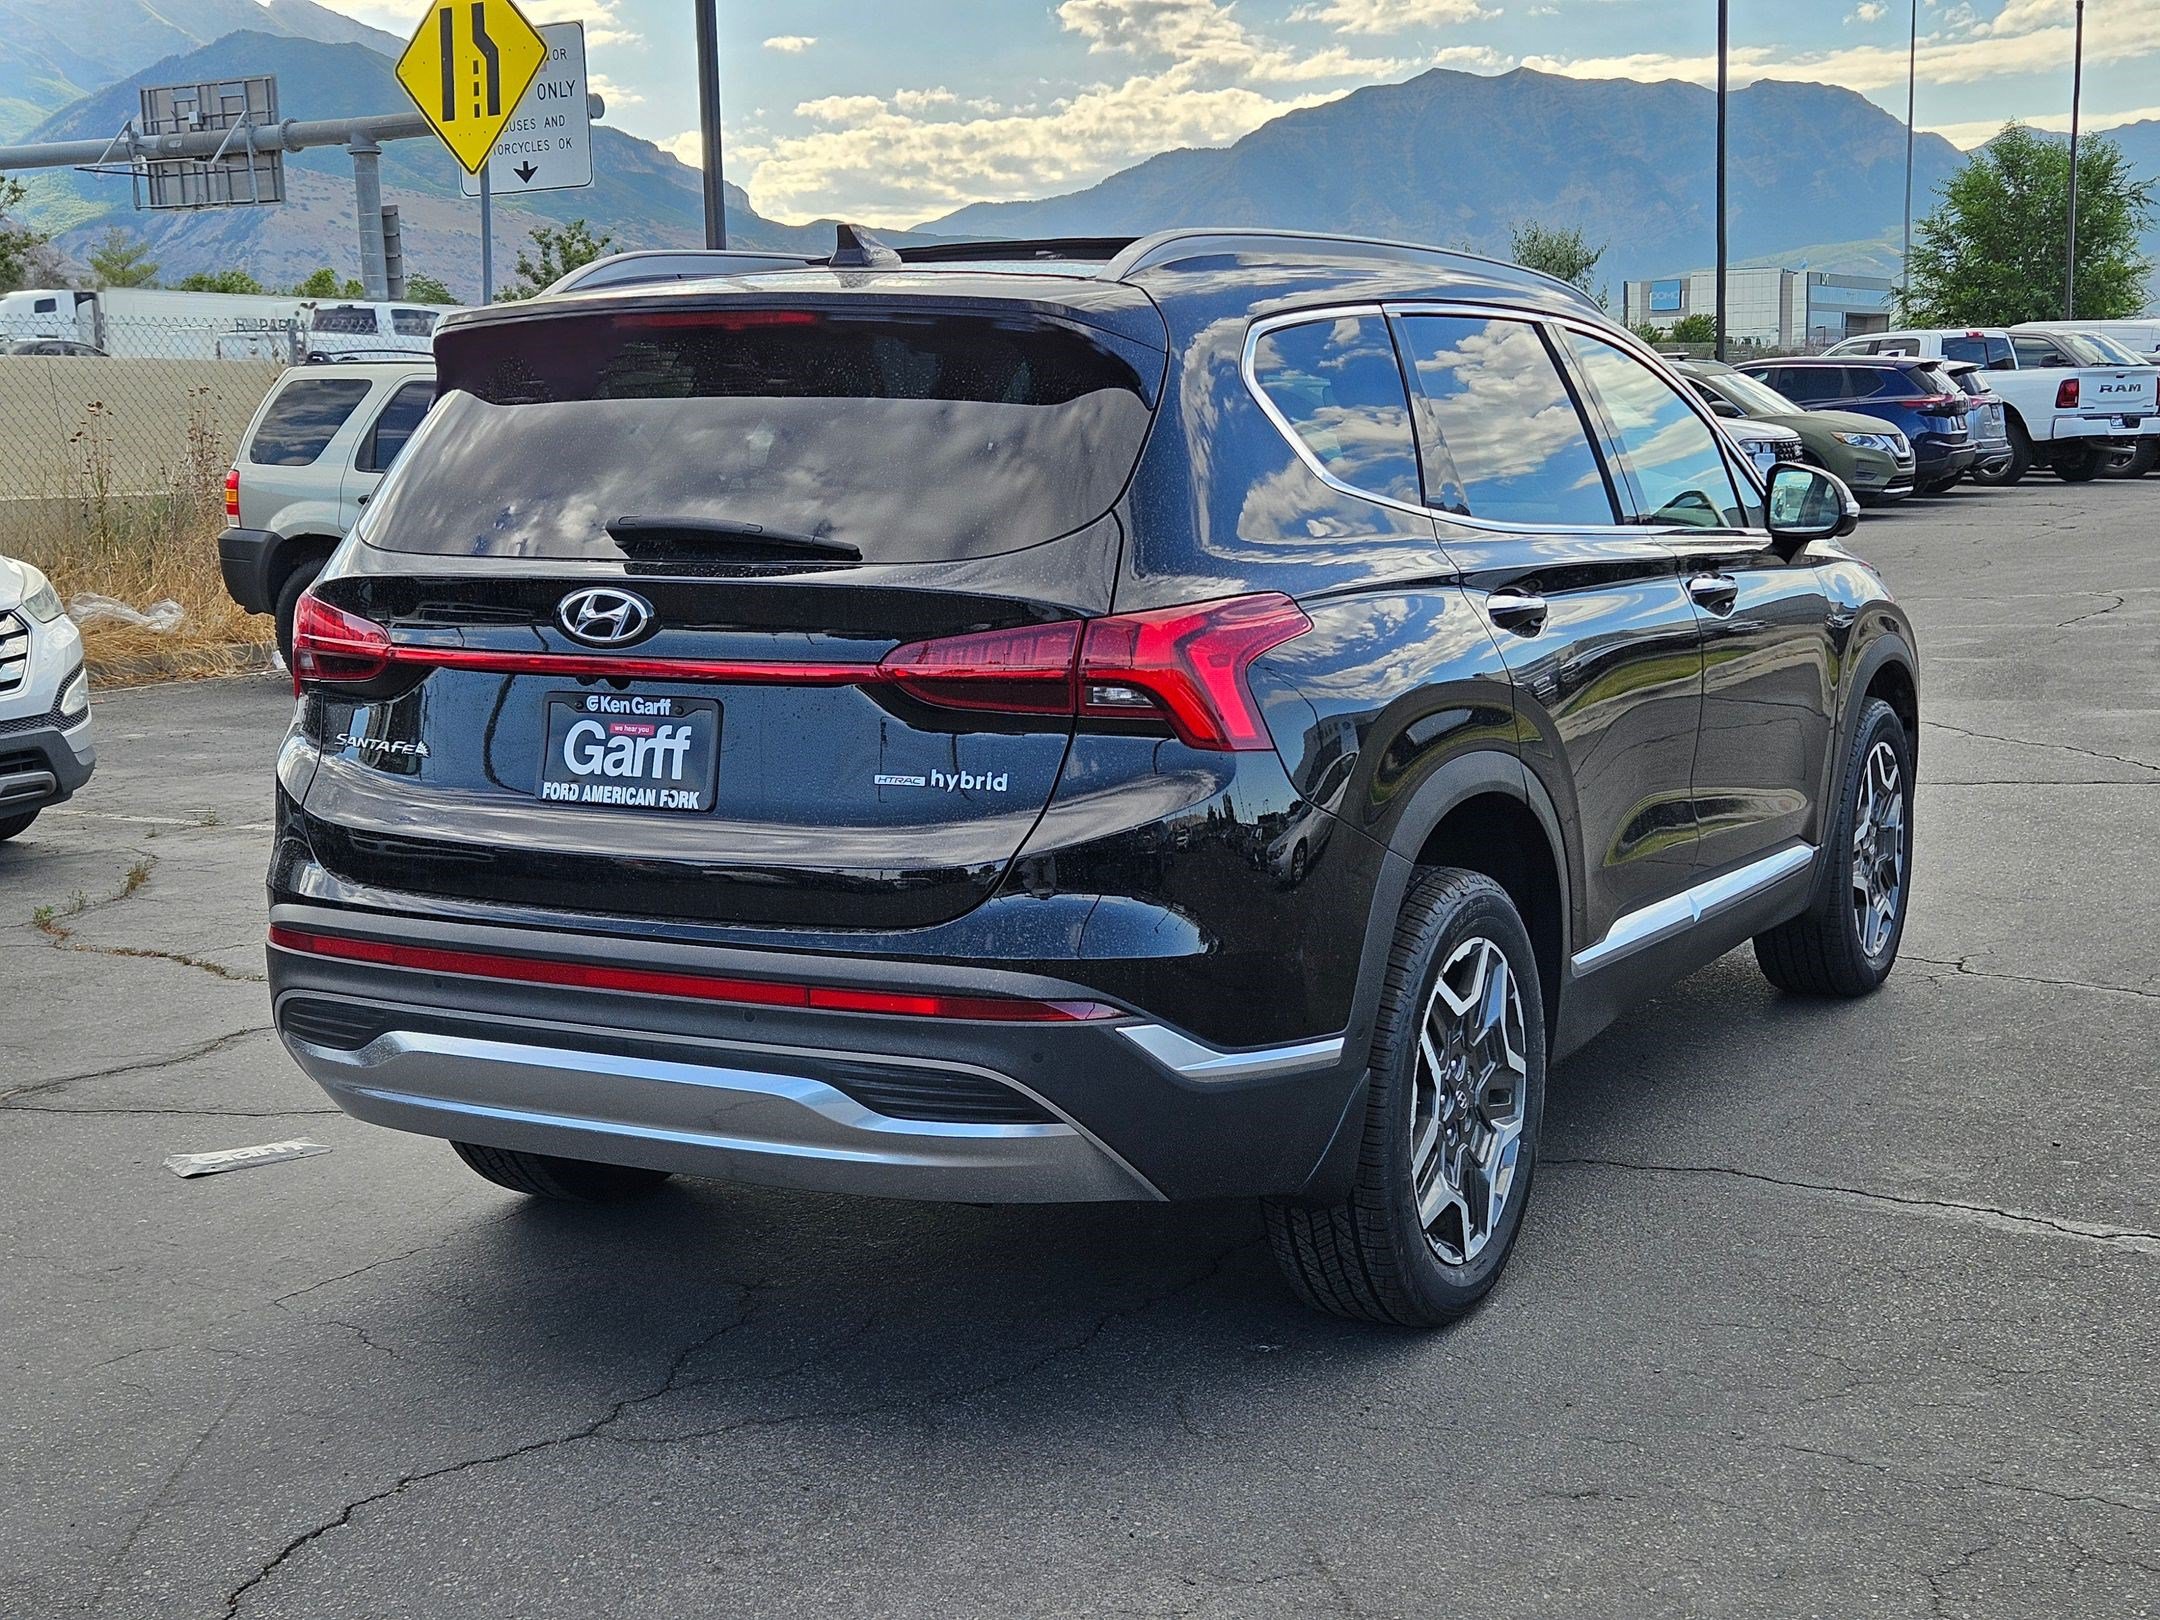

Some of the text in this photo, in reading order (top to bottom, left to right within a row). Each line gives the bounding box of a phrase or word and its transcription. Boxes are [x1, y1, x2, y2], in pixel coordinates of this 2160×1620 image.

[552, 48, 567, 60] OR
[537, 79, 576, 101] ONLY
[544, 114, 566, 128] AND
[493, 137, 573, 156] ORCYCLES OK
[2099, 383, 2142, 393] RAM
[600, 695, 631, 714] Ken
[631, 696, 672, 716] Garff
[624, 724, 638, 733] hear
[637, 726, 650, 734] you
[563, 719, 692, 780] Garff
[877, 768, 1009, 793] HTRAC hybrid
[542, 782, 700, 810] FORD AMERICAN FORK
